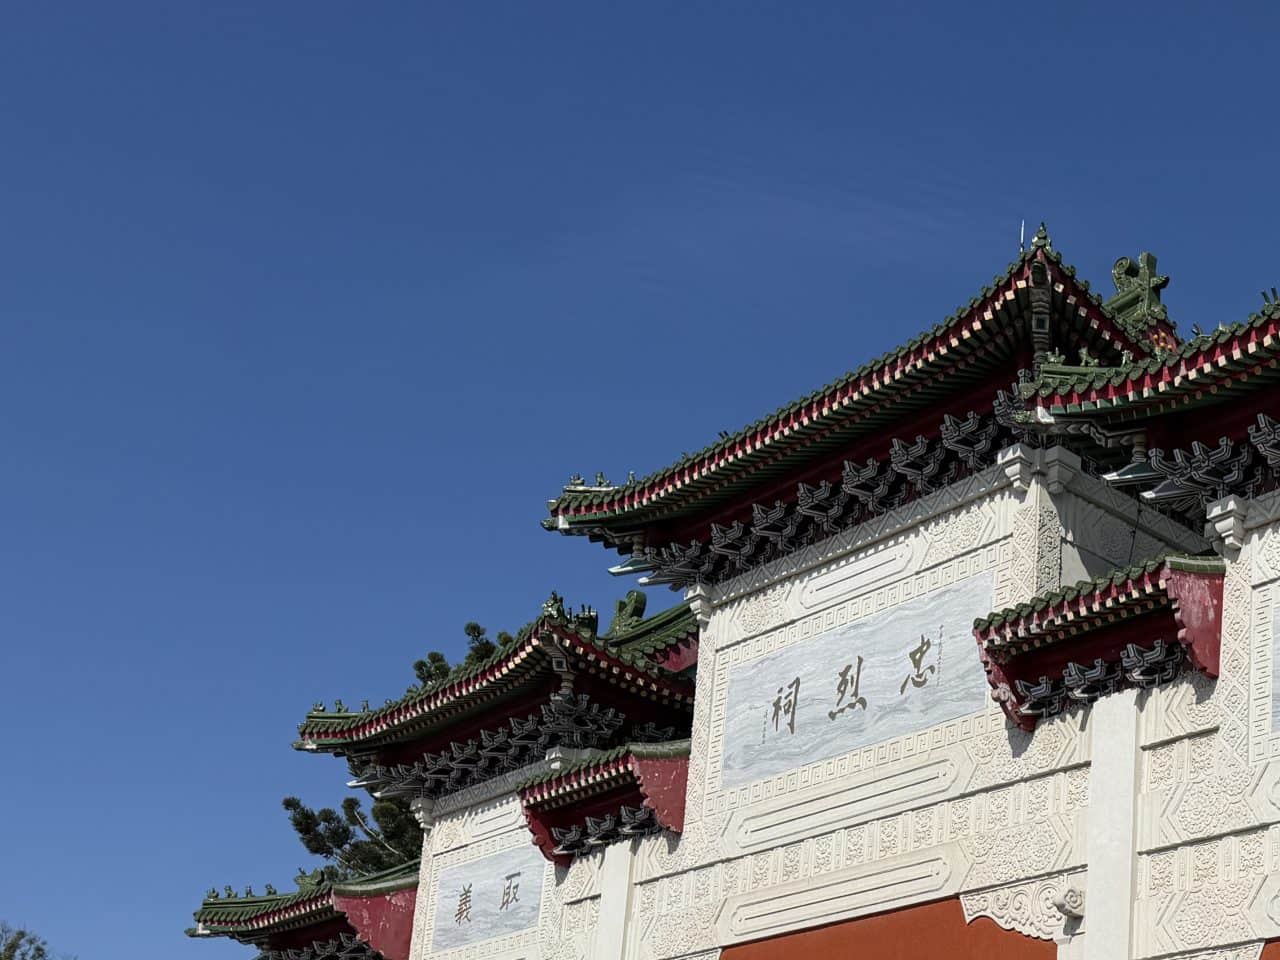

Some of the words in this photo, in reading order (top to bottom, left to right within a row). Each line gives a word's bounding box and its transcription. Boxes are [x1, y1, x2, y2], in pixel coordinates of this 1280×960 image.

[771, 634, 935, 735] 忠烈祠
[455, 872, 521, 926] 取義
